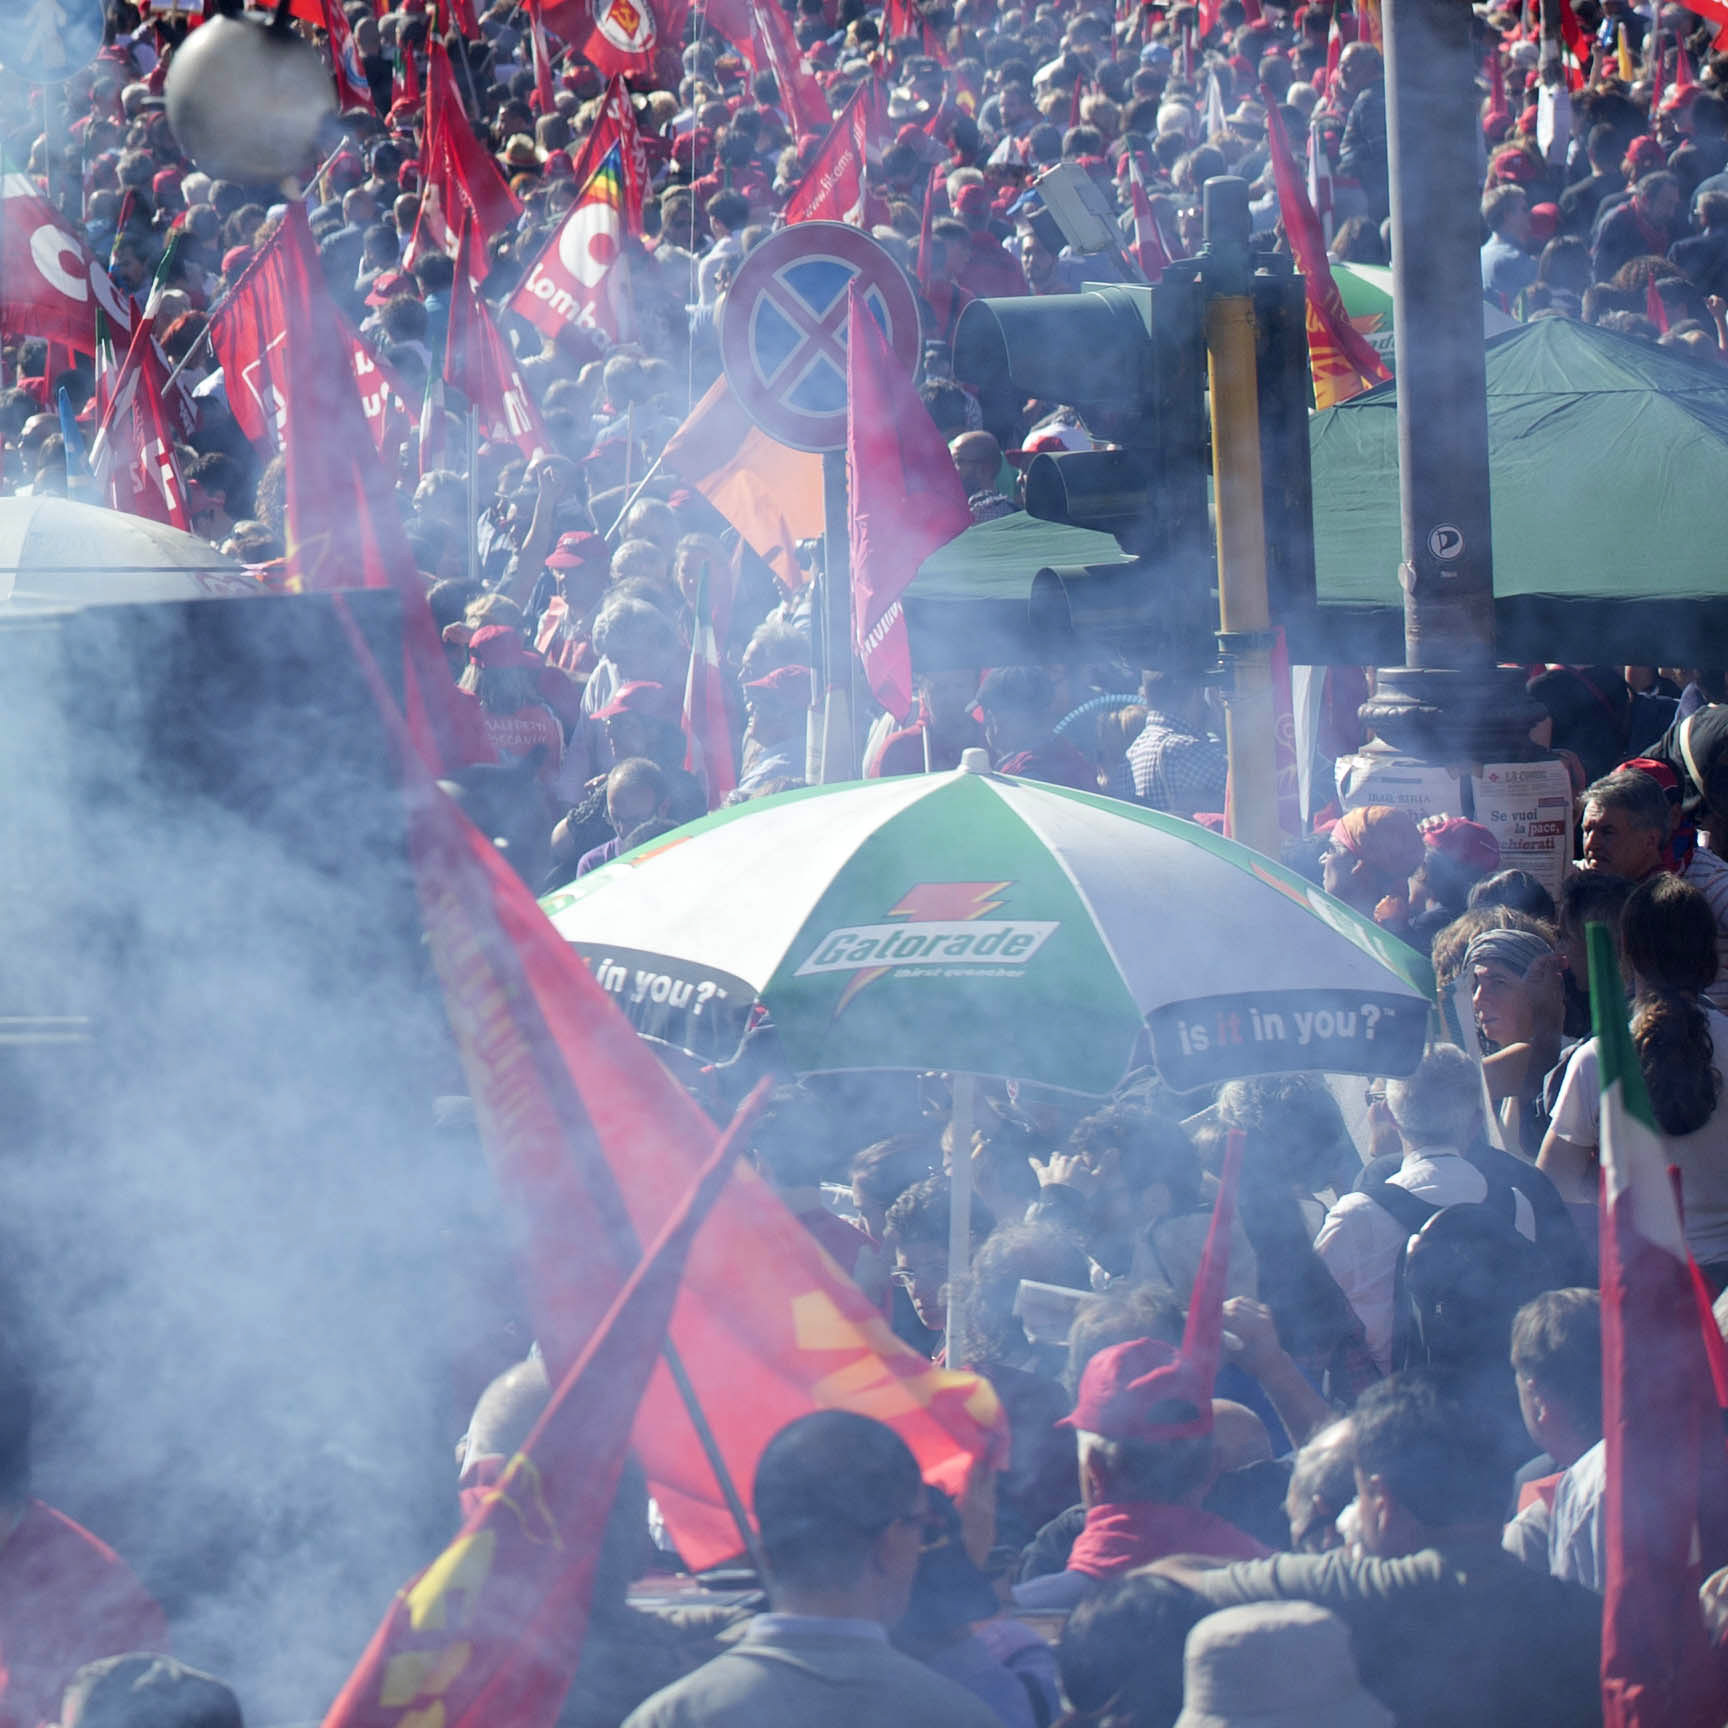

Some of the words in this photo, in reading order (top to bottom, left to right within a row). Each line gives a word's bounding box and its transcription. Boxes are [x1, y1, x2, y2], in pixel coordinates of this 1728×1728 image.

[1490, 810, 1508, 822] Se
[1512, 807, 1538, 822] vuoi
[816, 925, 1041, 971] Gatorade
[1178, 1017, 1211, 1056] is
[1215, 1010, 1242, 1048] it
[1250, 1004, 1286, 1043] in
